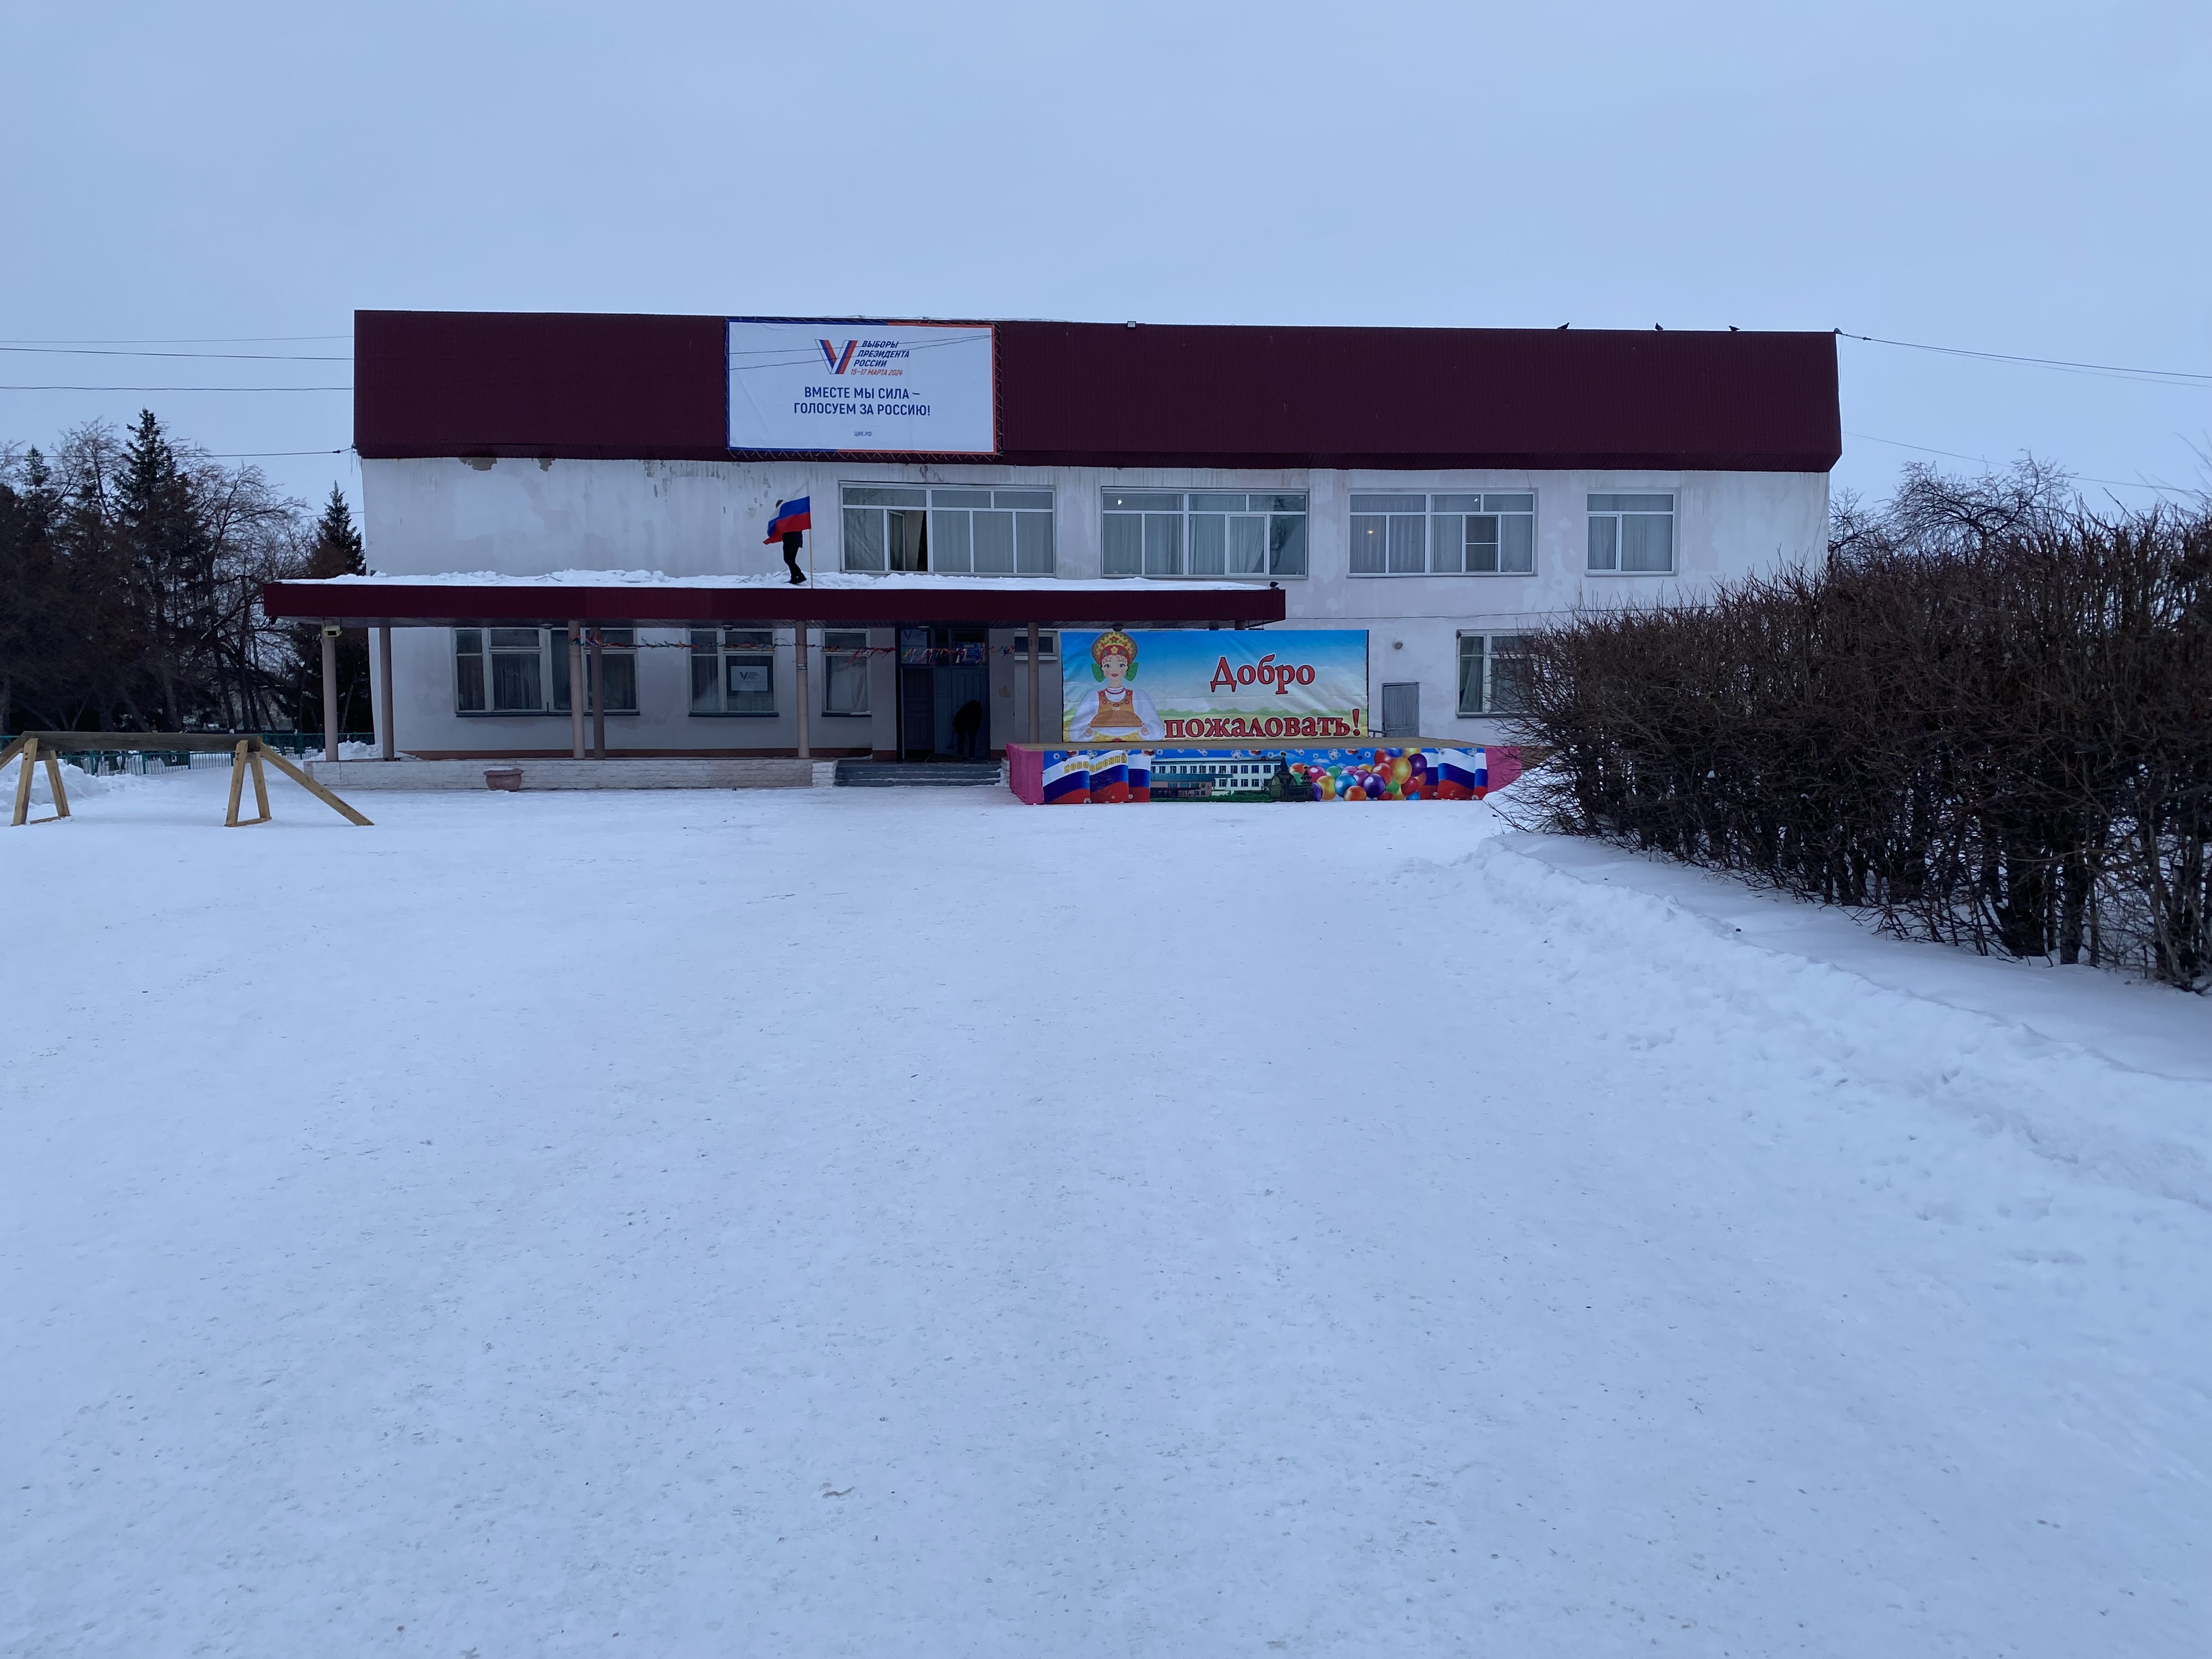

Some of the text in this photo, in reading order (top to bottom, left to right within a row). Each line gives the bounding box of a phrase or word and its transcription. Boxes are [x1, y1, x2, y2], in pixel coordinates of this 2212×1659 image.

[862, 340, 899, 348] ВЫБОРЫ
[857, 350, 910, 358] ПРЕЗИДЕНТА
[804, 387, 850, 398] ВМЕСТЕ
[854, 388, 874, 399] МЫ
[878, 388, 909, 399] СИЛА
[794, 403, 930, 416] ГОЛОСУЕМ ЗА РОССИЮ!
[1210, 653, 1316, 695] Добро
[1164, 709, 1361, 738] пожаловать!
